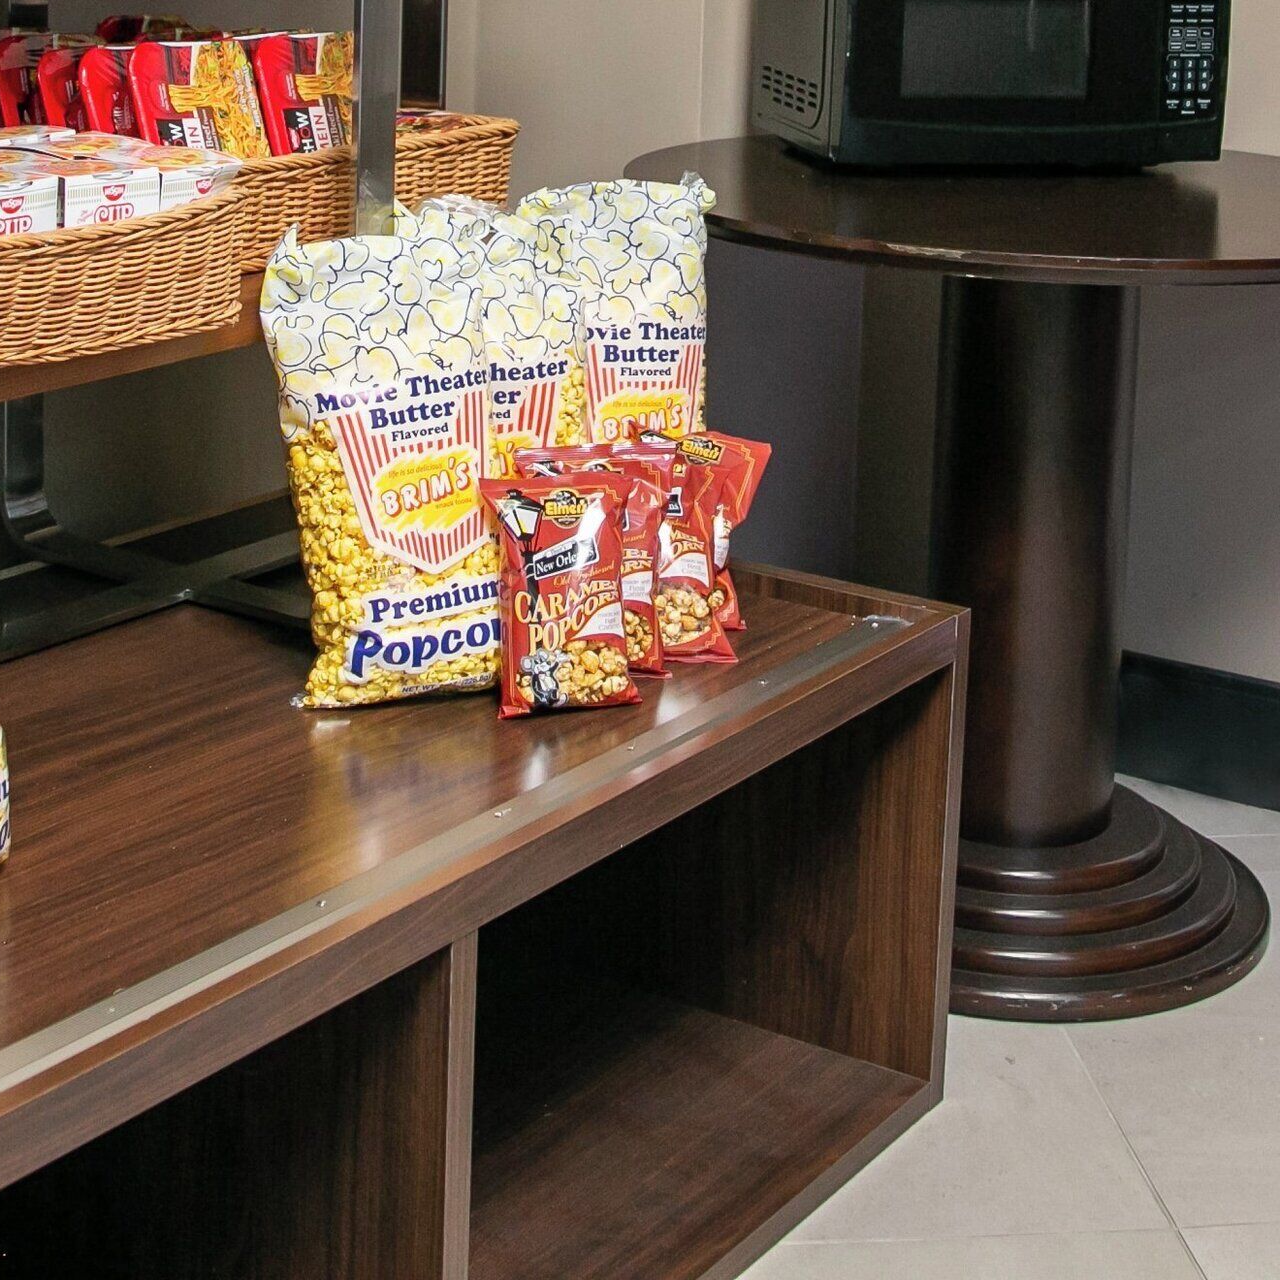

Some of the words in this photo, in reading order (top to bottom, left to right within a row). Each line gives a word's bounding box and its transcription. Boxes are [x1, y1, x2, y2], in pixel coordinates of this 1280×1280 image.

[586, 324, 632, 340] ovie
[639, 322, 706, 341] Theater
[603, 344, 680, 362] Butter
[489, 358, 569, 383] heater
[620, 366, 672, 376] Flavored
[314, 382, 398, 415] Movie
[405, 368, 488, 398] Theater
[370, 400, 455, 429] Butter
[391, 422, 449, 443] Flavored
[380, 456, 470, 519] BRIM'S
[545, 500, 588, 516] Elmer's
[535, 558, 555, 575] New
